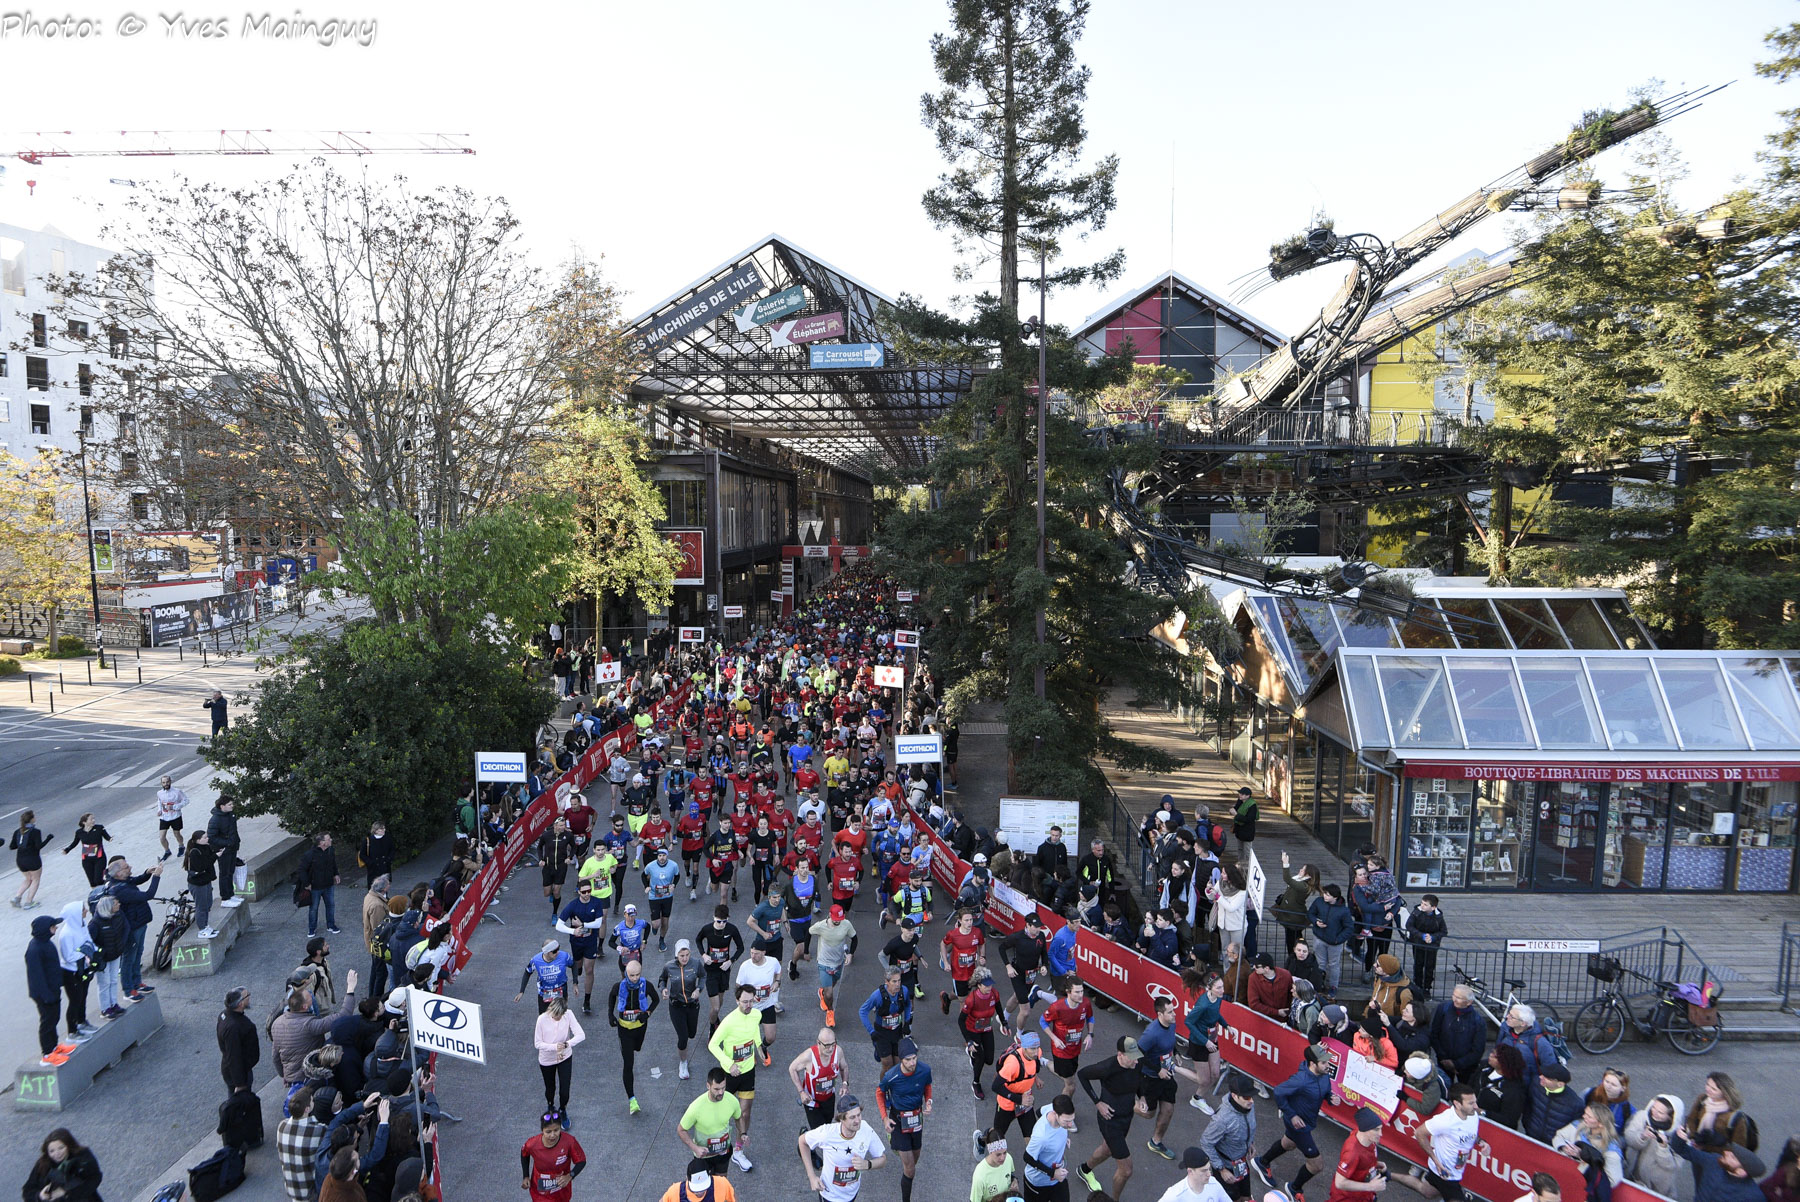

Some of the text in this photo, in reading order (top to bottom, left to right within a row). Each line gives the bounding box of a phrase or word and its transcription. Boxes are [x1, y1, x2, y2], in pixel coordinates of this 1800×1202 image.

[757, 298, 786, 314] Galerie
[764, 304, 788, 316] Machines
[646, 301, 709, 345] MACHINES
[708, 289, 728, 307] DE
[811, 320, 826, 328] Grand
[792, 326, 828, 340] Éléphant
[826, 350, 863, 359] Carrousel
[155, 605, 186, 619] BOOMIN
[900, 745, 937, 753] DECATHLON
[482, 763, 522, 773] DECATHLON
[1464, 766, 1611, 781] BOUTIQUE-LIBRAIRIE
[1616, 768, 1642, 780] DES
[1646, 767, 1718, 780] MACHINES
[1723, 768, 1742, 780] DE
[1528, 941, 1568, 949] TICKETS
[176, 947, 210, 961] ATP
[1075, 944, 1129, 984] UNDAI
[416, 1029, 481, 1059] HYUNDAI
[20, 1075, 56, 1098] ATP
[1351, 1071, 1388, 1095] ALLEZ
[1345, 1091, 1361, 1102] GO!
